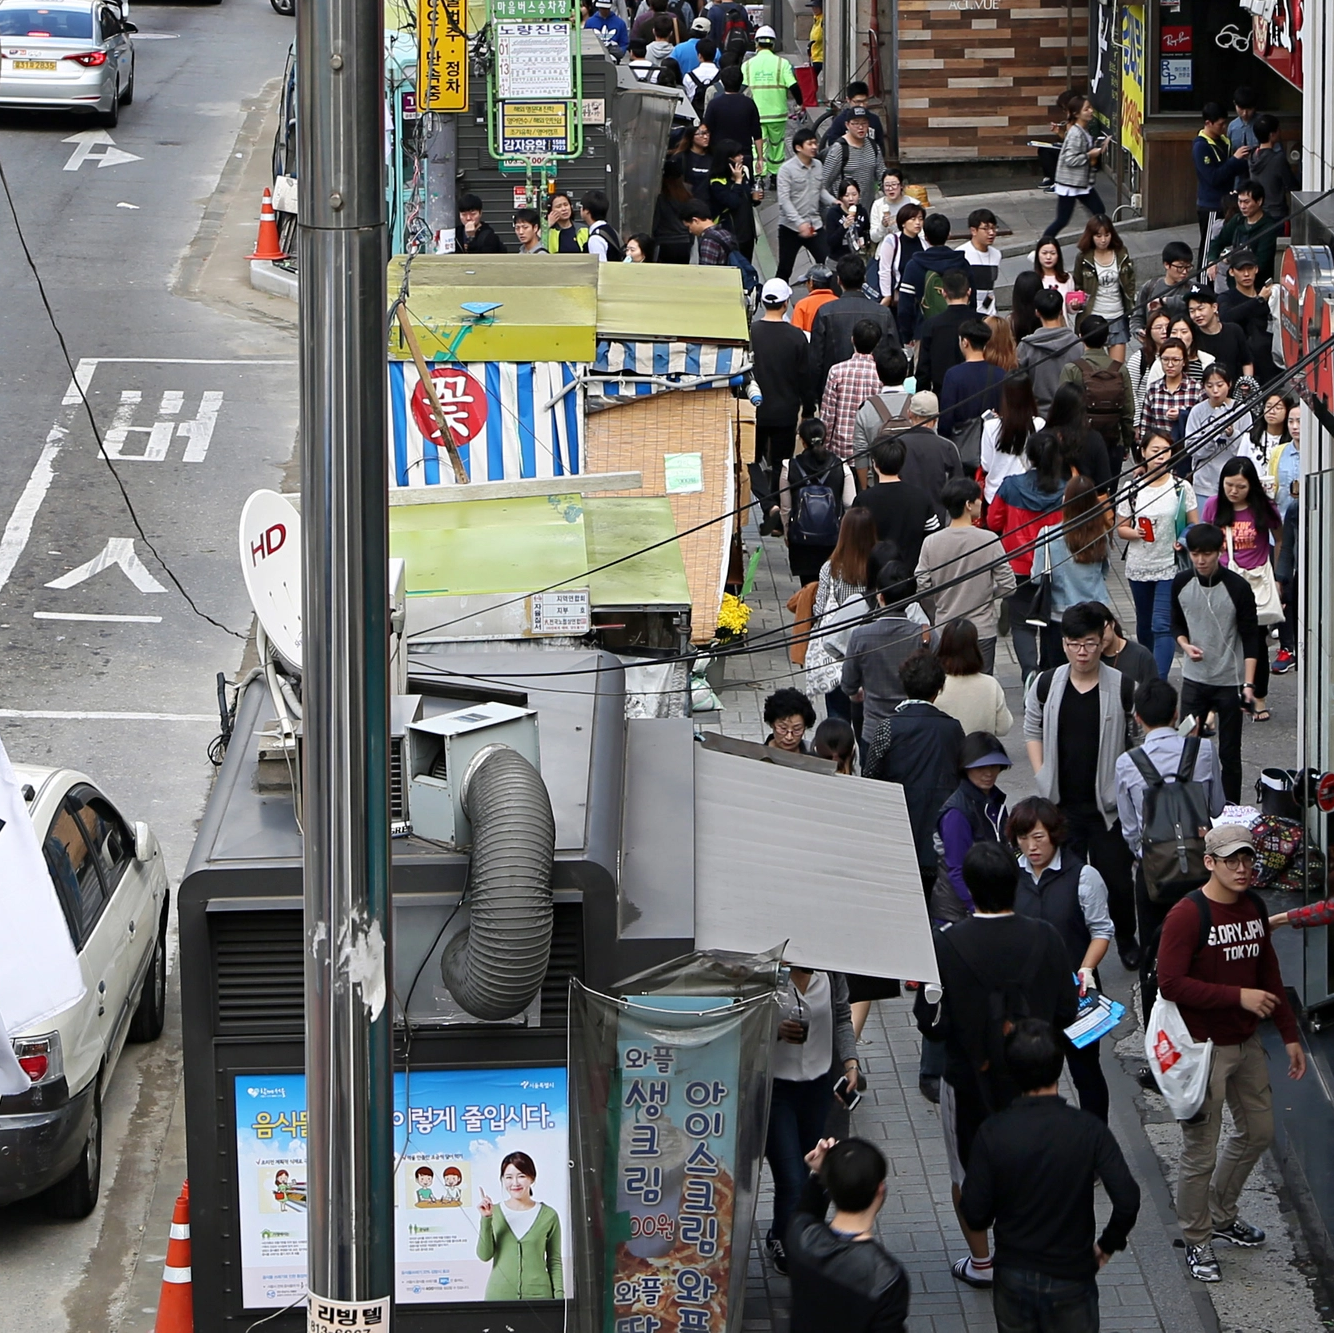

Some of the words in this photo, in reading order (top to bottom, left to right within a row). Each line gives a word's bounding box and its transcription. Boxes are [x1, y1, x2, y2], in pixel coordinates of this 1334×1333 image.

[497, 0, 567, 15] 마을버스승차장
[499, 24, 568, 36] 노량진역
[499, 43, 509, 55] 01
[499, 64, 510, 75] 13
[504, 139, 547, 151] 감자유학
[422, 377, 475, 439] 꽃
[250, 522, 287, 568] HD
[1223, 943, 1260, 962] TOKYO
[624, 1045, 675, 1074] 와플
[393, 1104, 457, 1135] 이렇게
[460, 1101, 556, 1133] 줄입시다.
[624, 1078, 668, 1206] 생크림
[677, 1080, 729, 1258] 아이스크림
[614, 1275, 663, 1306] 와플
[317, 1304, 383, 1327] 리빙텔
